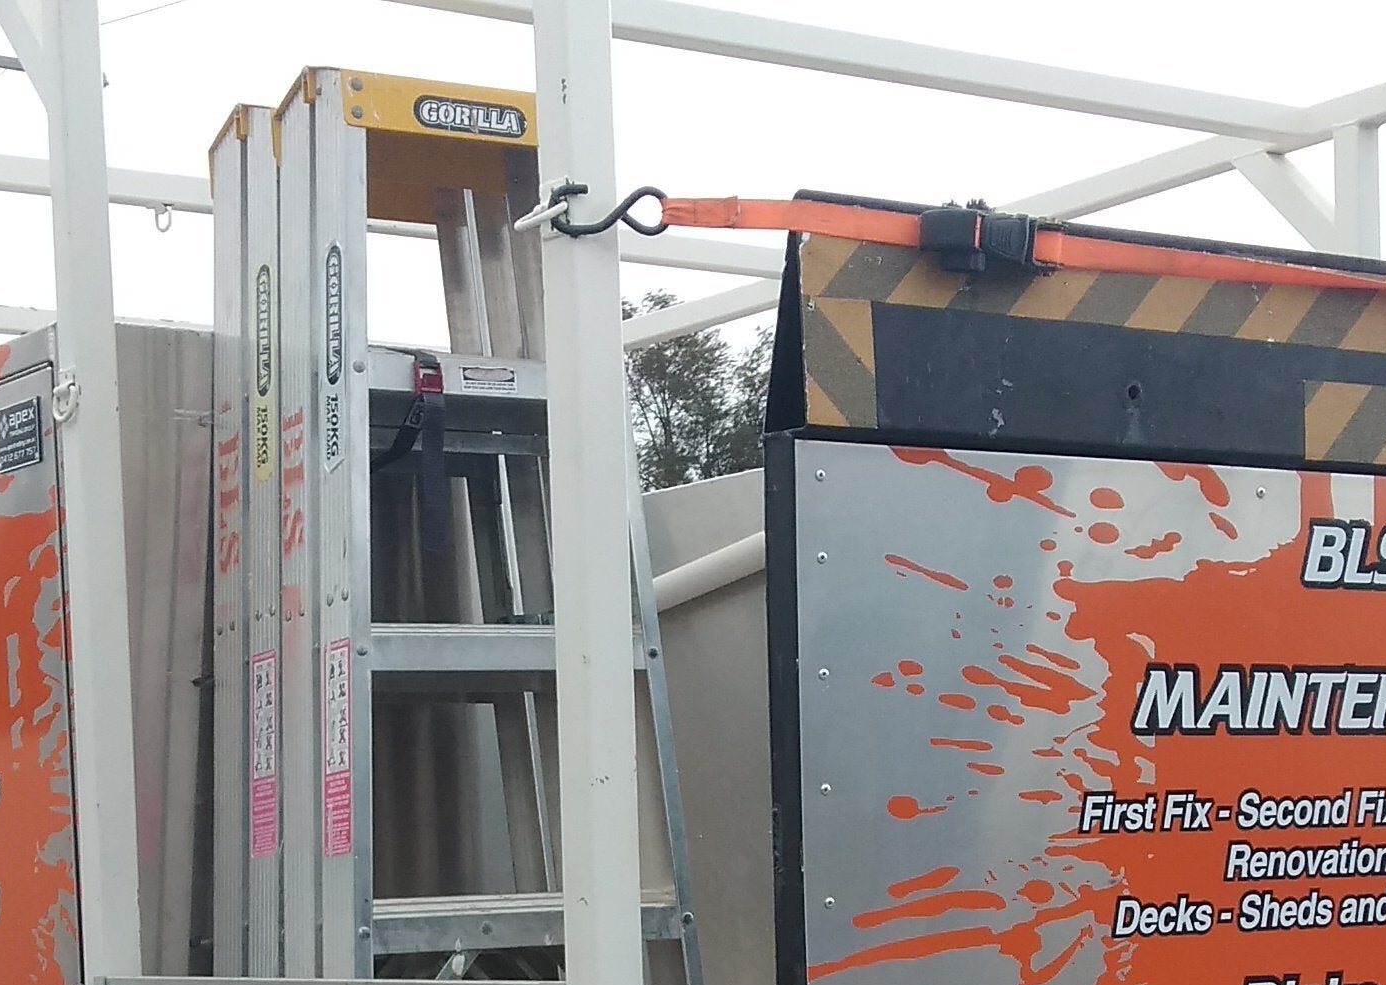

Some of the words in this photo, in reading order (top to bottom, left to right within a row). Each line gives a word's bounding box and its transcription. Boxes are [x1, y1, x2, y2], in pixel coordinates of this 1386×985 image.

[419, 100, 521, 134] GORILLA
[258, 271, 271, 391] GORILLA
[327, 252, 341, 378] GORILLA
[8, 406, 35, 429] apex
[261, 405, 269, 465] 150KG
[330, 394, 339, 457] 150KG
[1081, 795, 1157, 831] First
[1163, 793, 1213, 829] Fix
[1238, 791, 1352, 828] Second
[1115, 897, 1213, 935] Decks
[1239, 892, 1333, 929] Sheds
